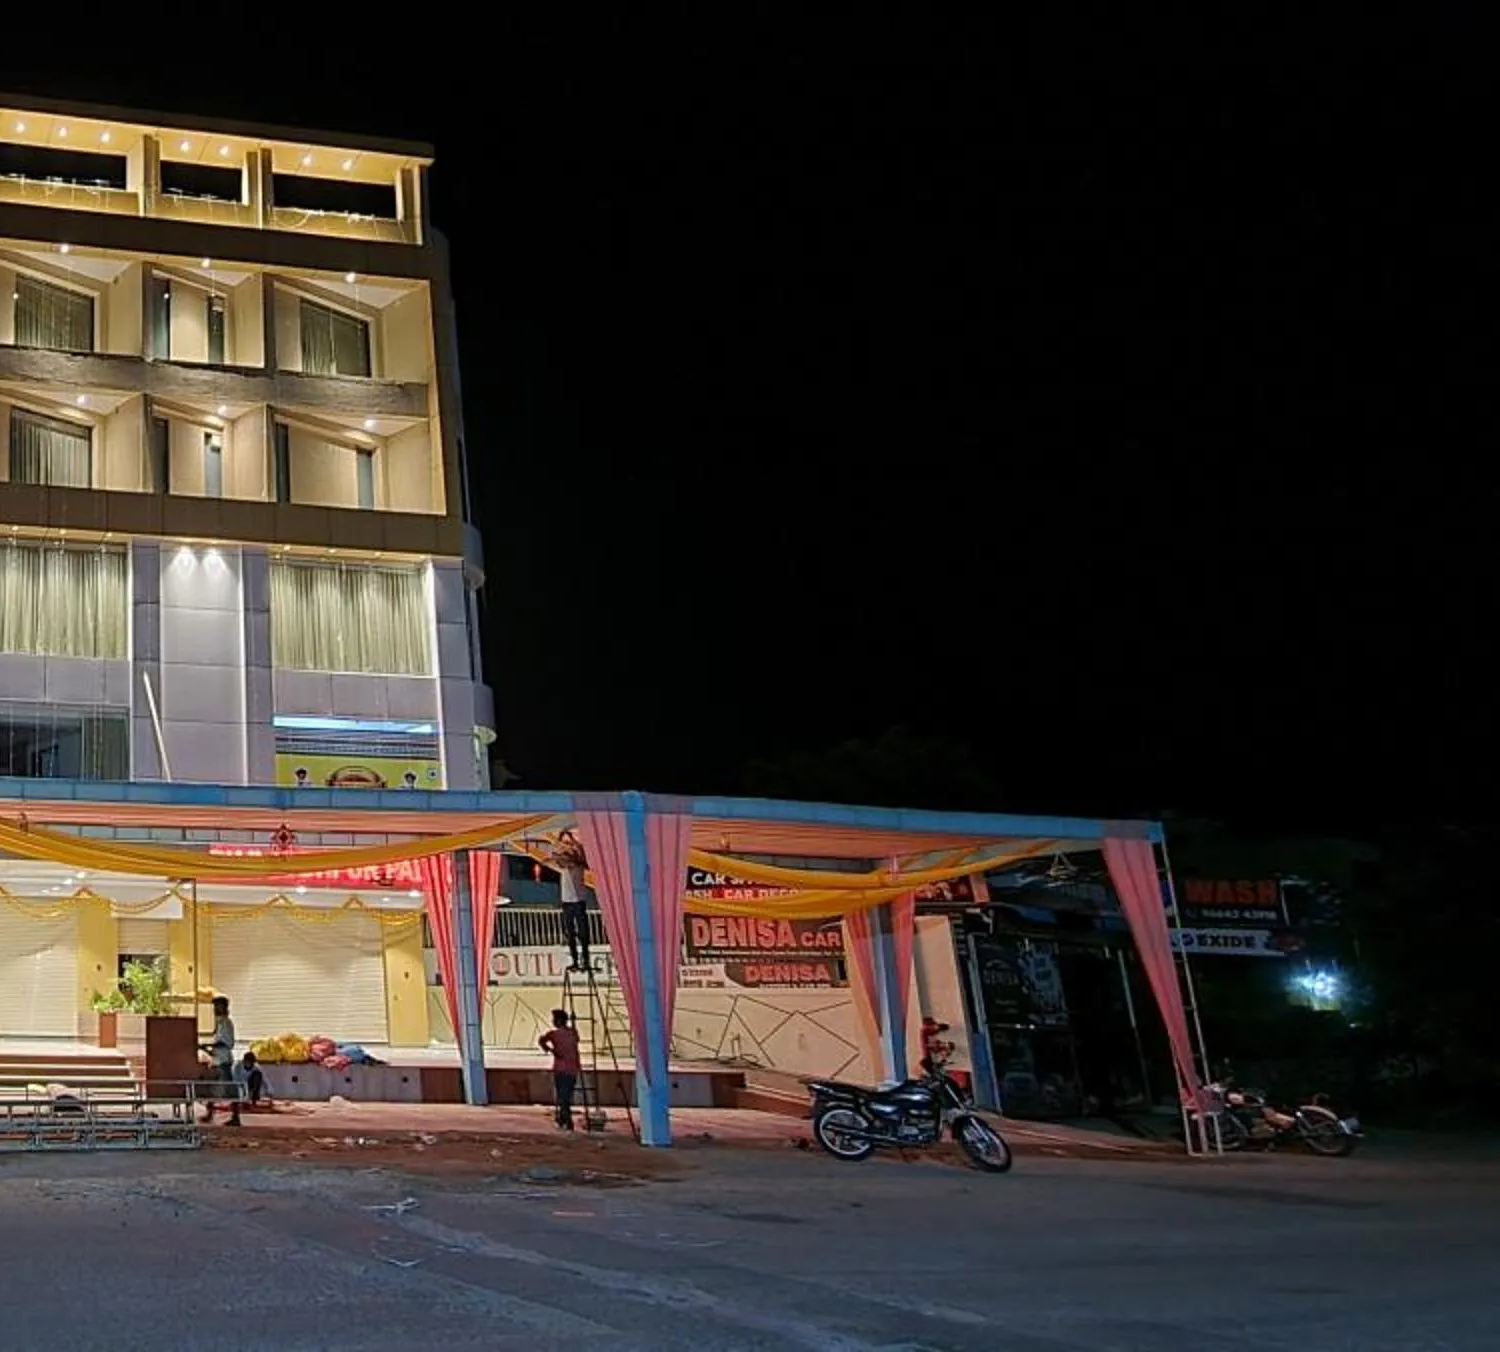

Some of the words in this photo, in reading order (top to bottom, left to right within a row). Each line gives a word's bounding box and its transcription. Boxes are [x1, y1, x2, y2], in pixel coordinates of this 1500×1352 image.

[691, 872, 726, 885] CAR
[1185, 880, 1276, 904] WASH
[691, 916, 797, 948] DENISA
[800, 931, 842, 948] CAR
[1196, 935, 1255, 949] EXIDE
[743, 963, 831, 983] DENISA
